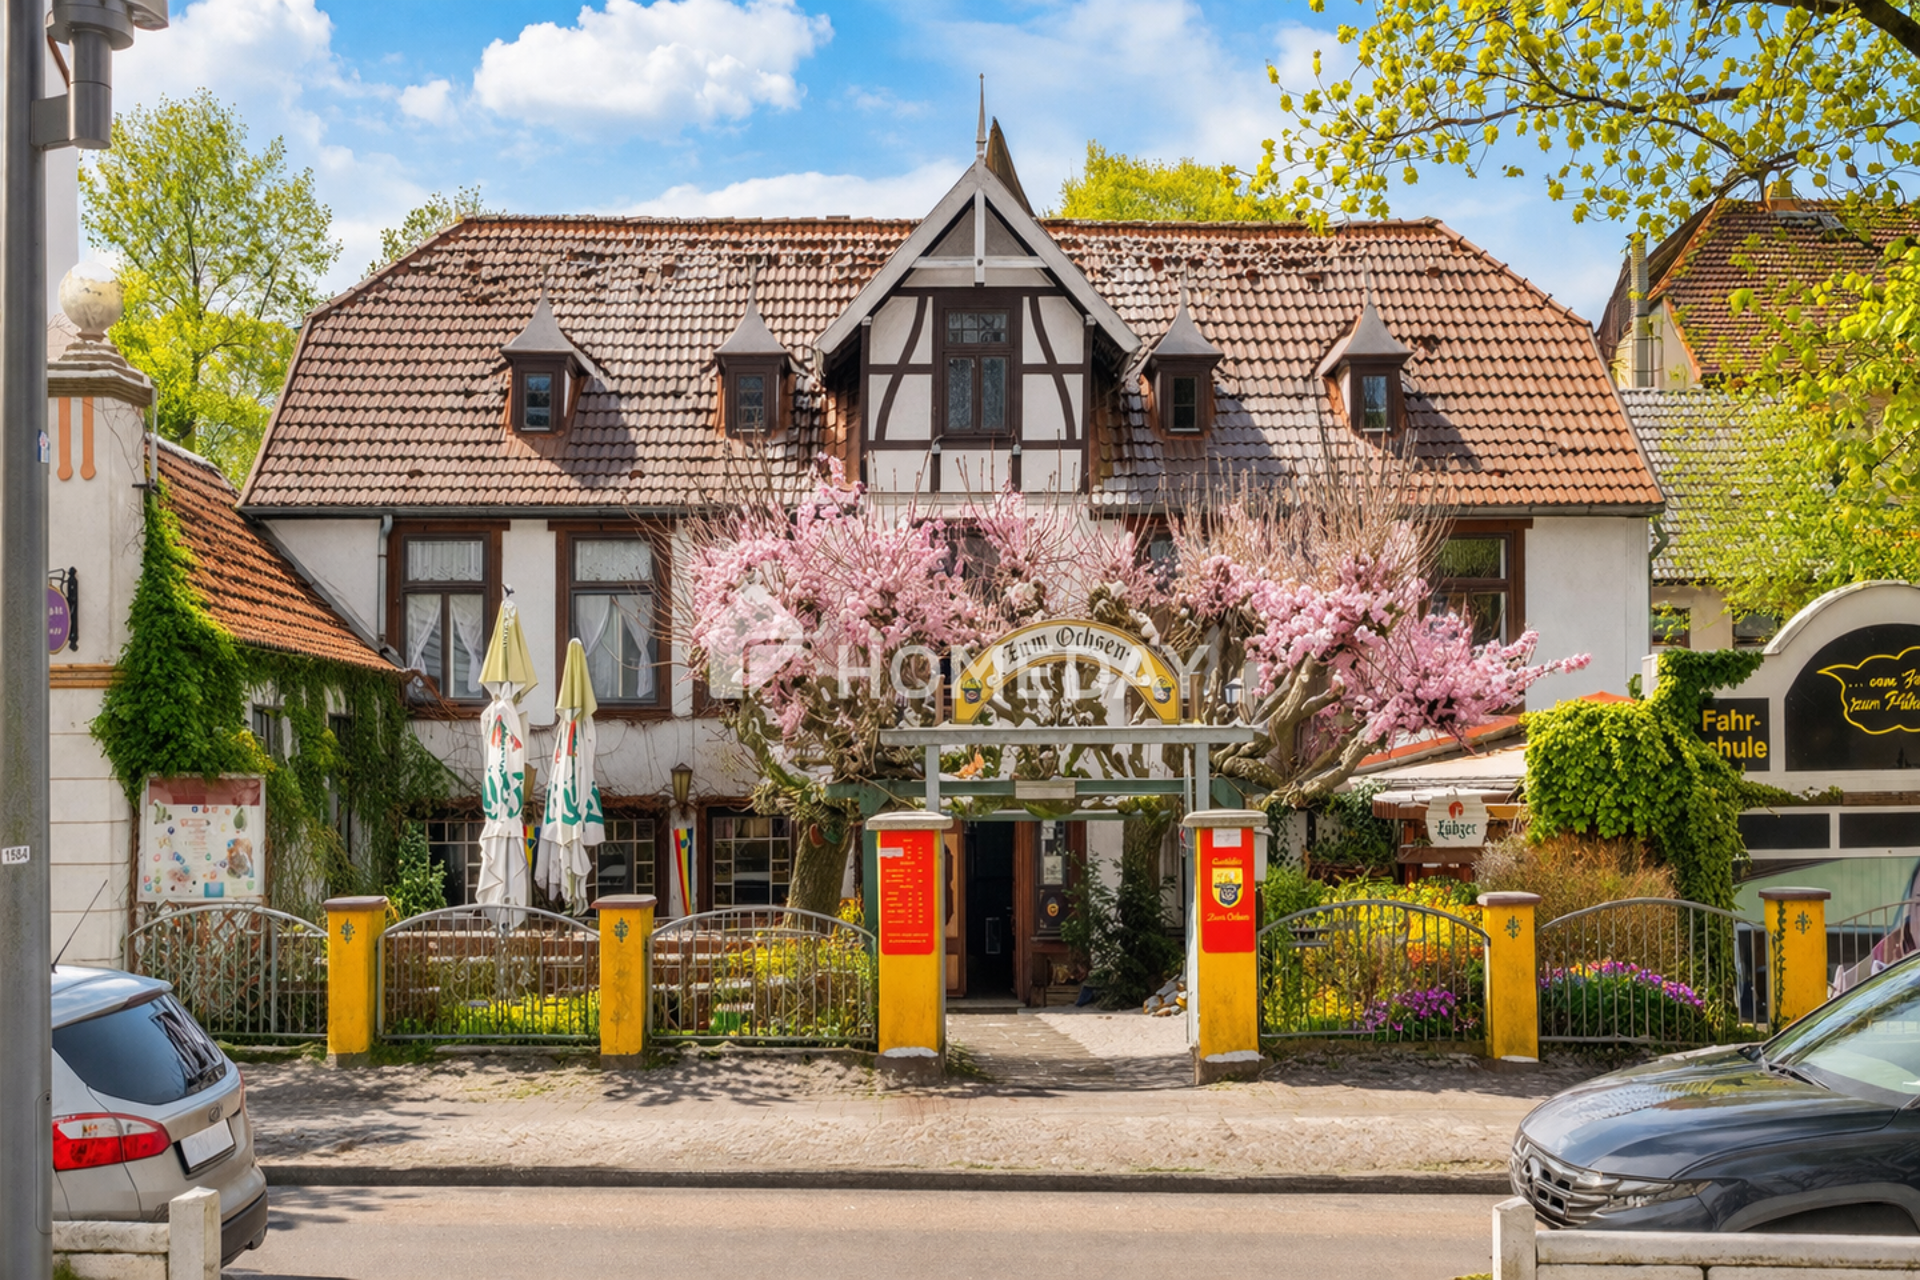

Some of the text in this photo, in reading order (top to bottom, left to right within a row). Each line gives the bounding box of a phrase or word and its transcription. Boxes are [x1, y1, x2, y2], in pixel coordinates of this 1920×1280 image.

[1003, 626, 1126, 665] Zum Ochsen
[1702, 709, 1762, 732] Fahr-
